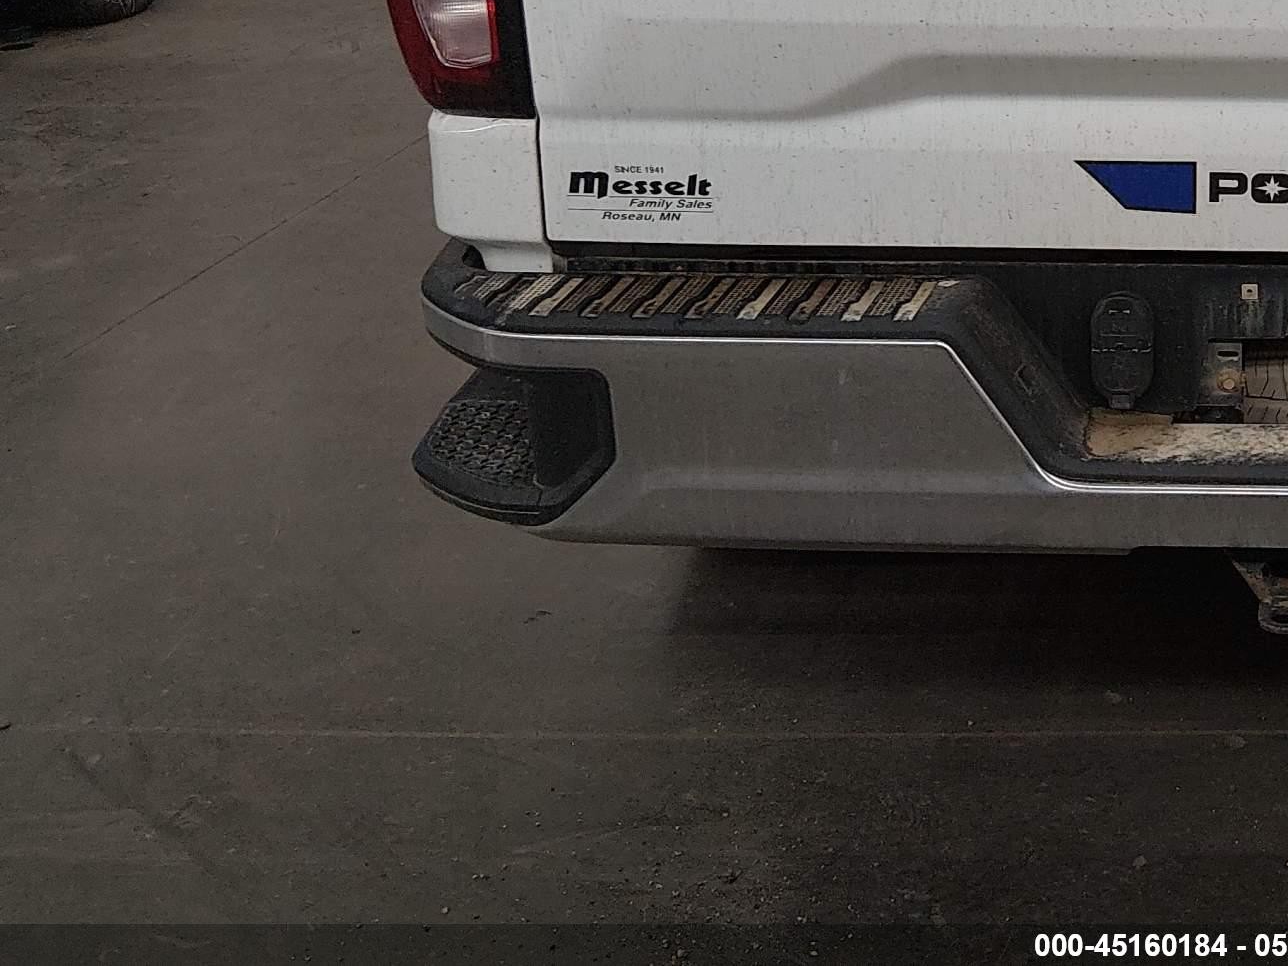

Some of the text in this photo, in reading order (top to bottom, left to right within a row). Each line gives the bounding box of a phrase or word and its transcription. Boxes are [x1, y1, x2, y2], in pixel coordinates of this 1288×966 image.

[614, 165, 664, 174] SINCE 1941
[629, 198, 712, 210] Family Sales
[601, 211, 681, 222] Roseau, MN
